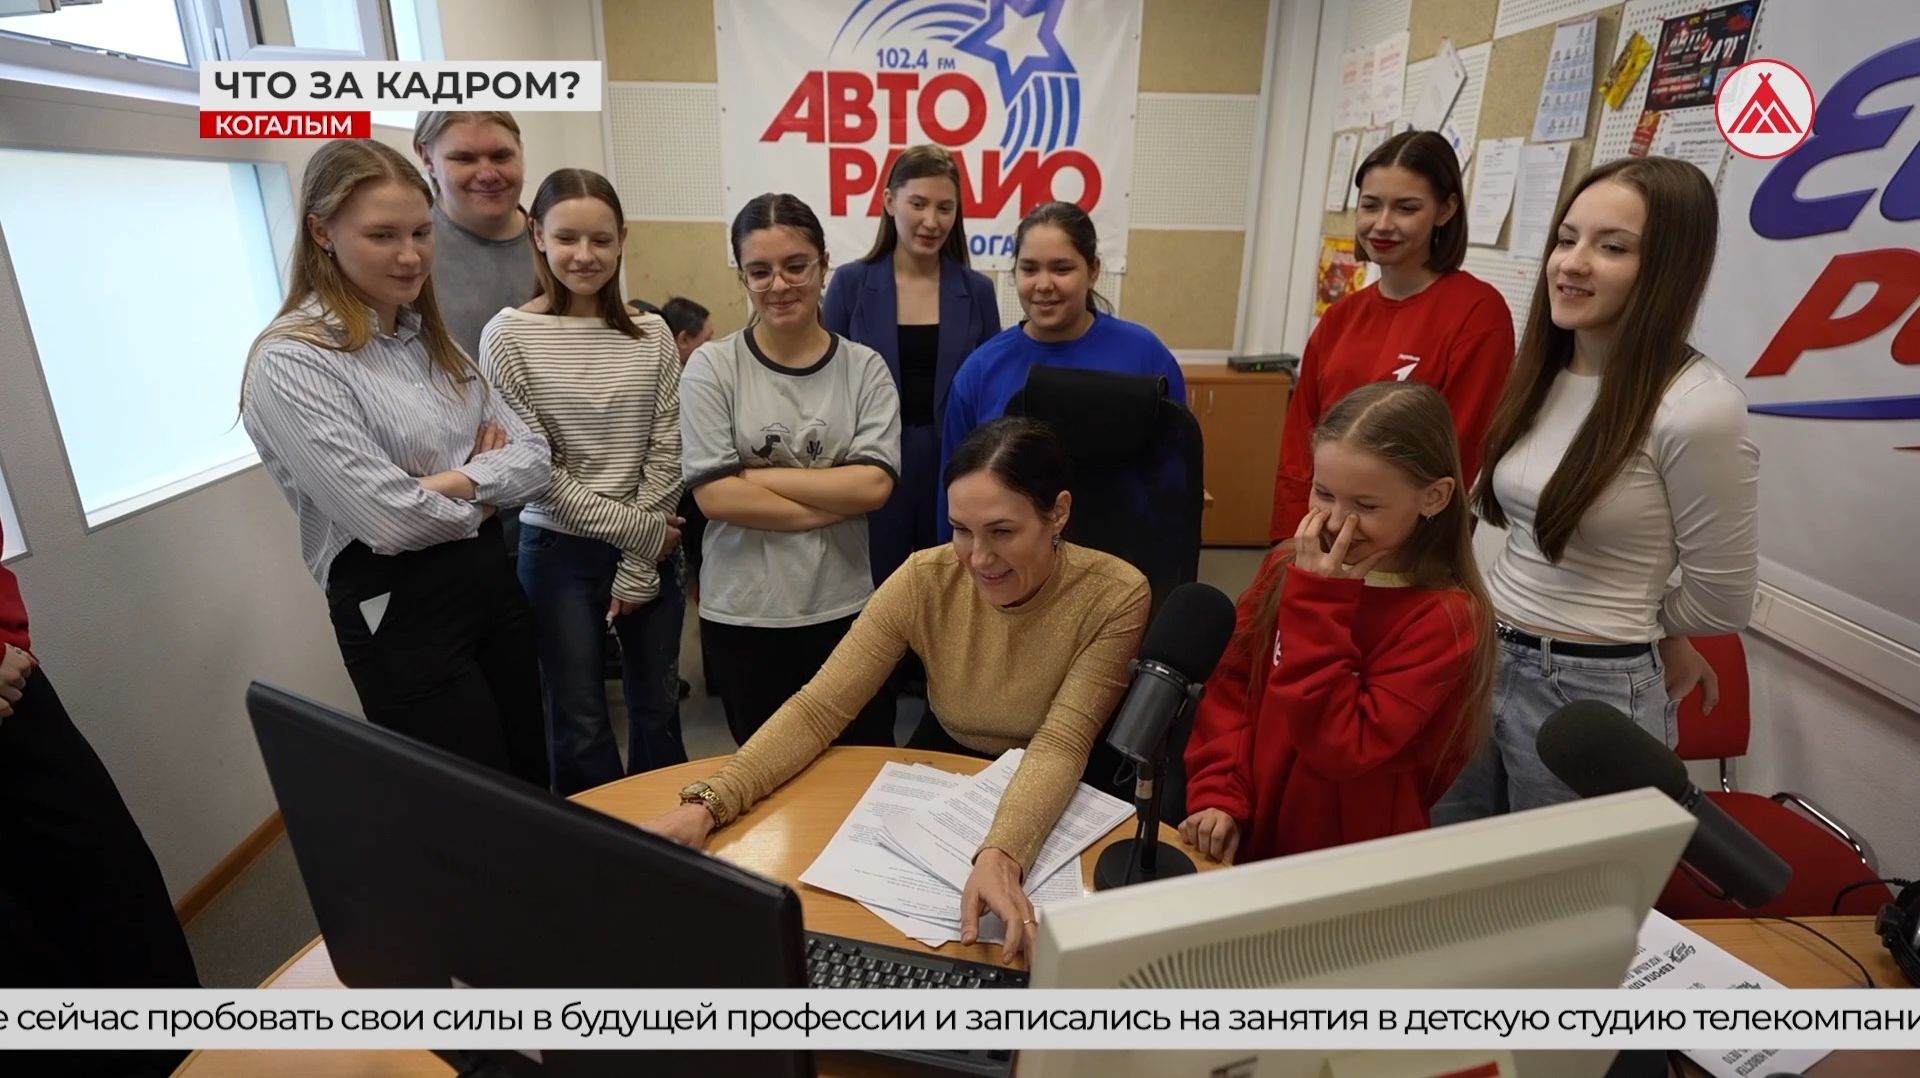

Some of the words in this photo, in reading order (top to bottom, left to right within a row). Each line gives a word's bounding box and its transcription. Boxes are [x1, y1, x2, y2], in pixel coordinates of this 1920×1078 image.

[876, 47, 929, 70] 102.4
[937, 57, 956, 70] FM
[760, 70, 988, 148] АВТО
